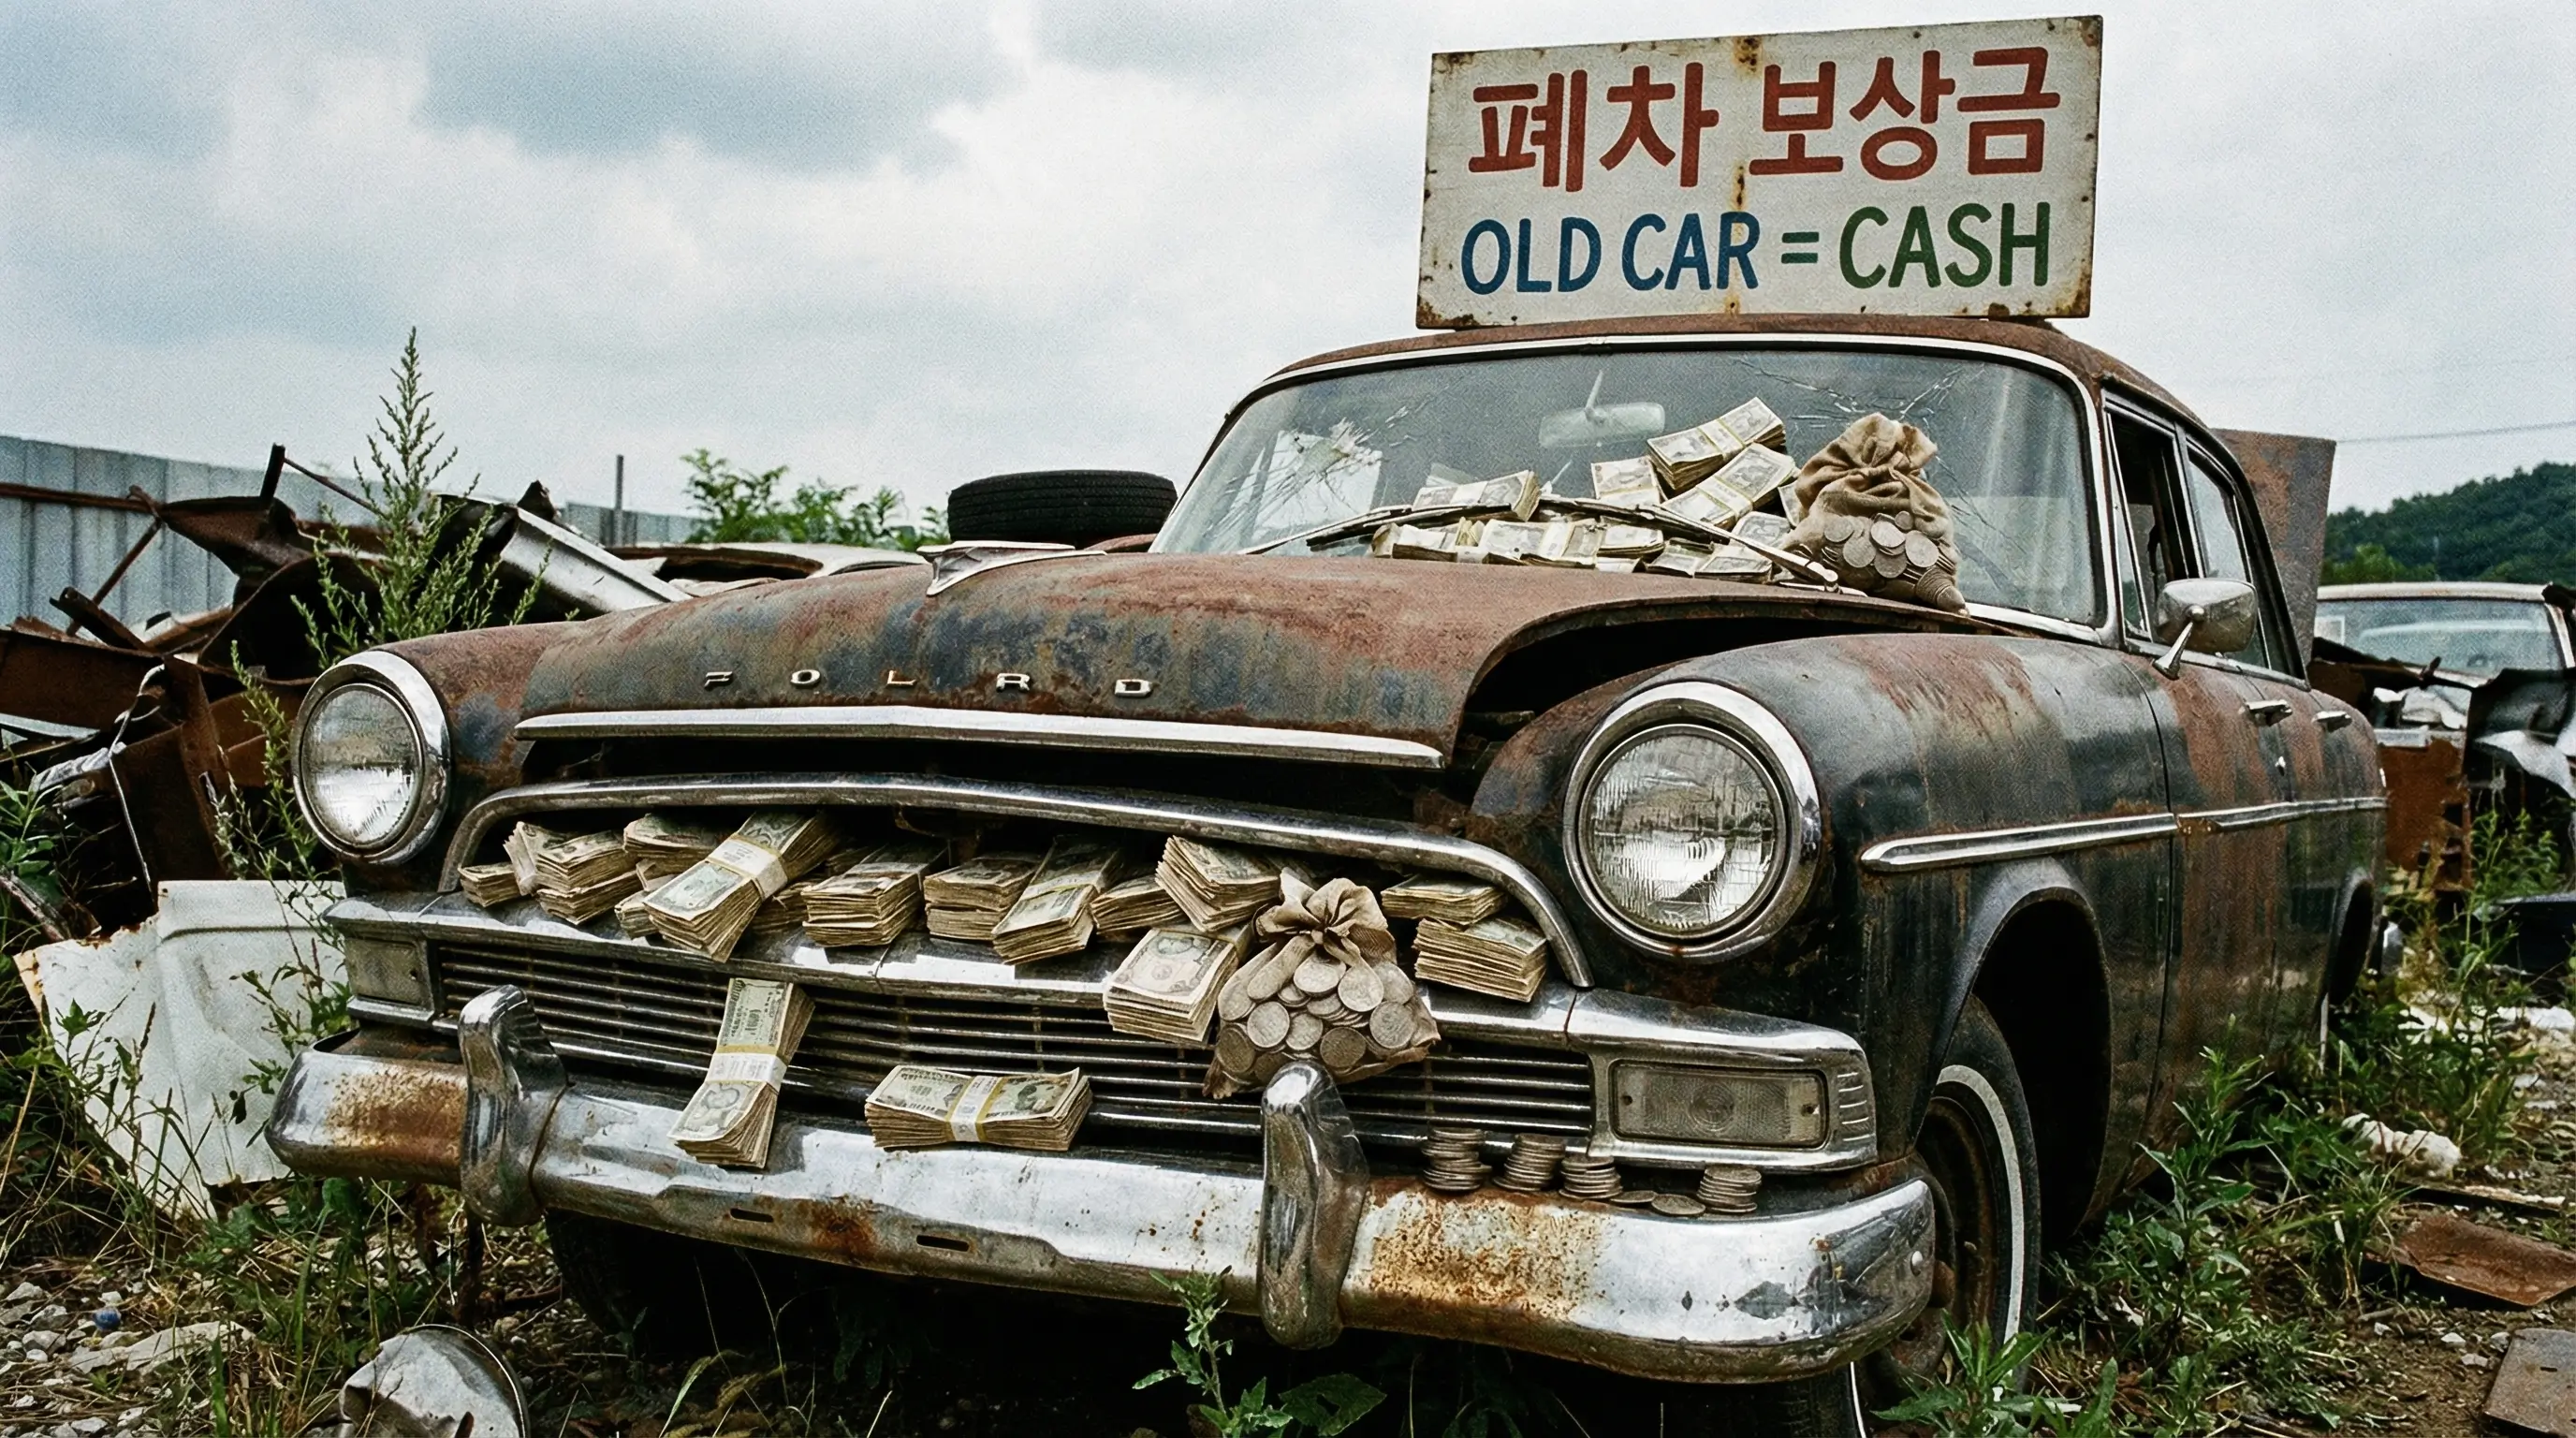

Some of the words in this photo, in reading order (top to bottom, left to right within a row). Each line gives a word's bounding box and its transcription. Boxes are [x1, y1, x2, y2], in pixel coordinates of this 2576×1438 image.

[1468, 62, 1720, 193] 폐차
[1749, 47, 2061, 182] 보상금
[1461, 217, 1602, 295] OLD
[1621, 212, 1761, 291] CAR
[1839, 201, 2052, 289] CASH
